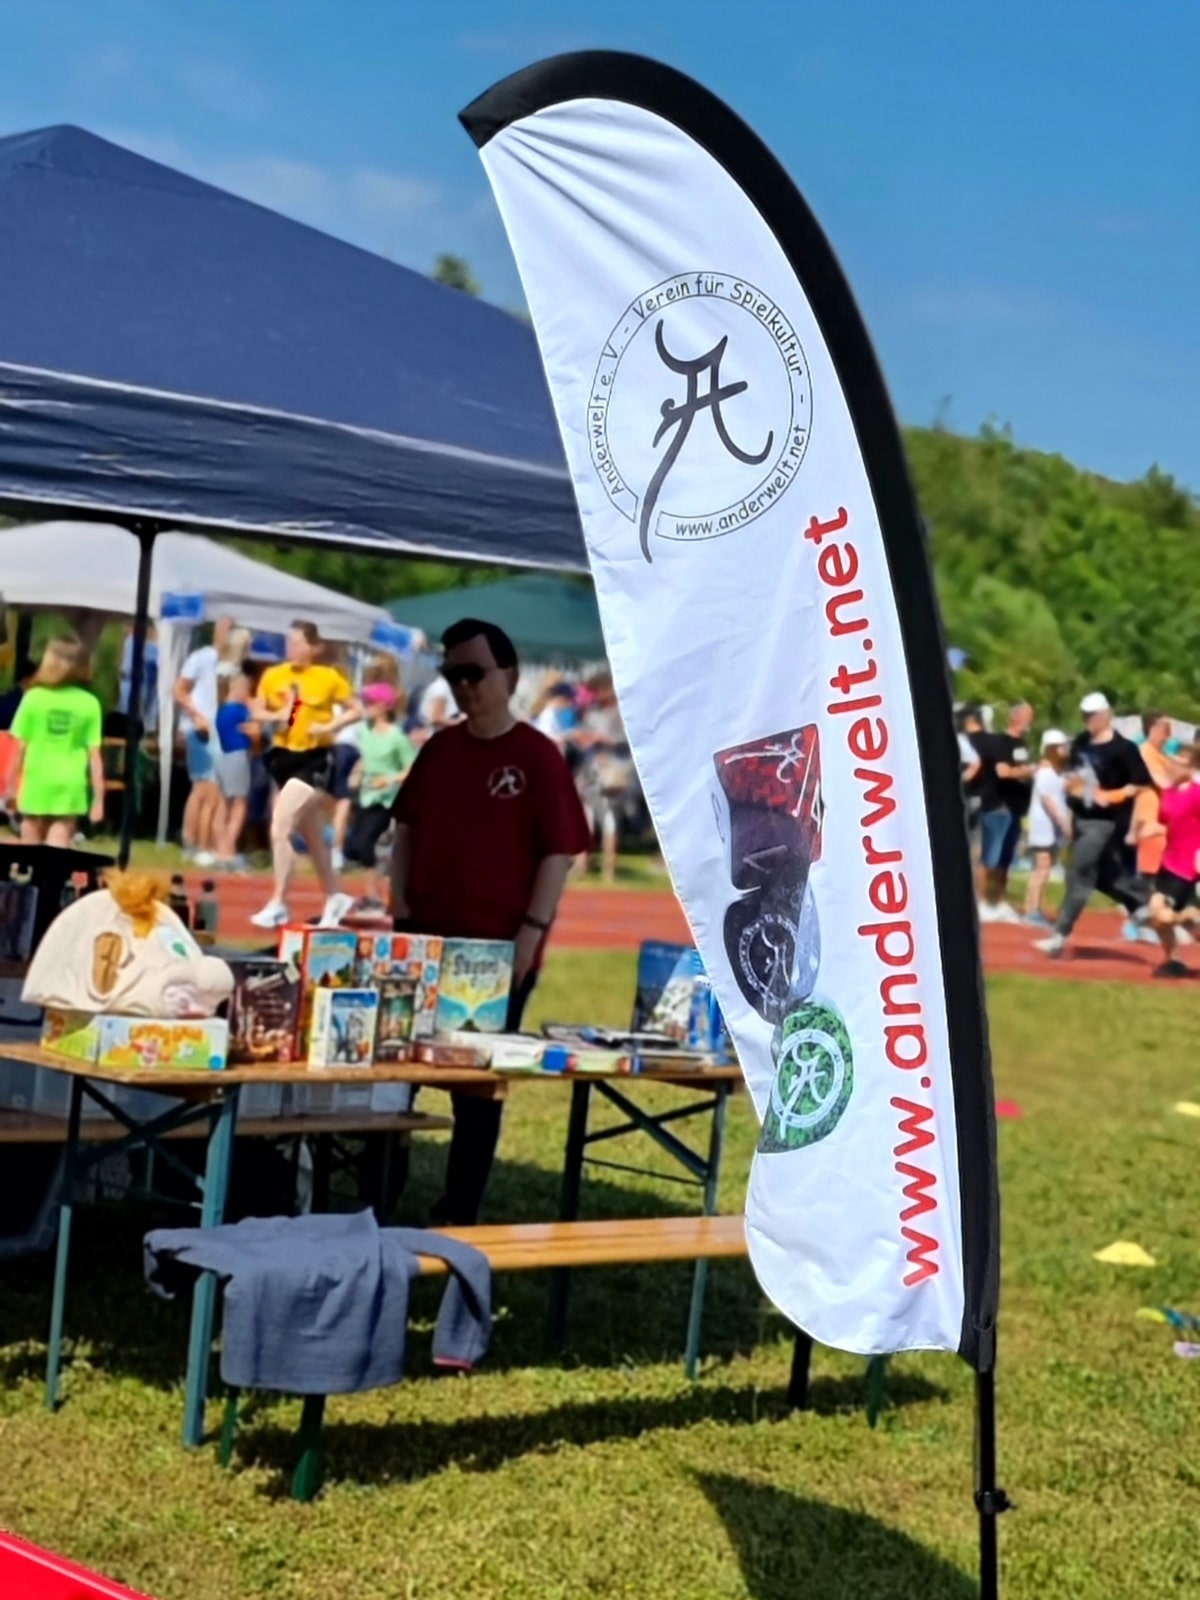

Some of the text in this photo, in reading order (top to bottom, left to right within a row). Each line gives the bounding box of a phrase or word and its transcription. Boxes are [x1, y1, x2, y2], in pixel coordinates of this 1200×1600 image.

[632, 280, 690, 318] Verein
[695, 274, 724, 295] für
[602, 342, 624, 359] V.
[730, 283, 803, 376] Spielkultur
[600, 371, 614, 386] e.
[589, 394, 625, 495] Anderwelt
[675, 424, 807, 536] www.anderwelt.net
[804, 505, 940, 1287] www.anderwelt.net
